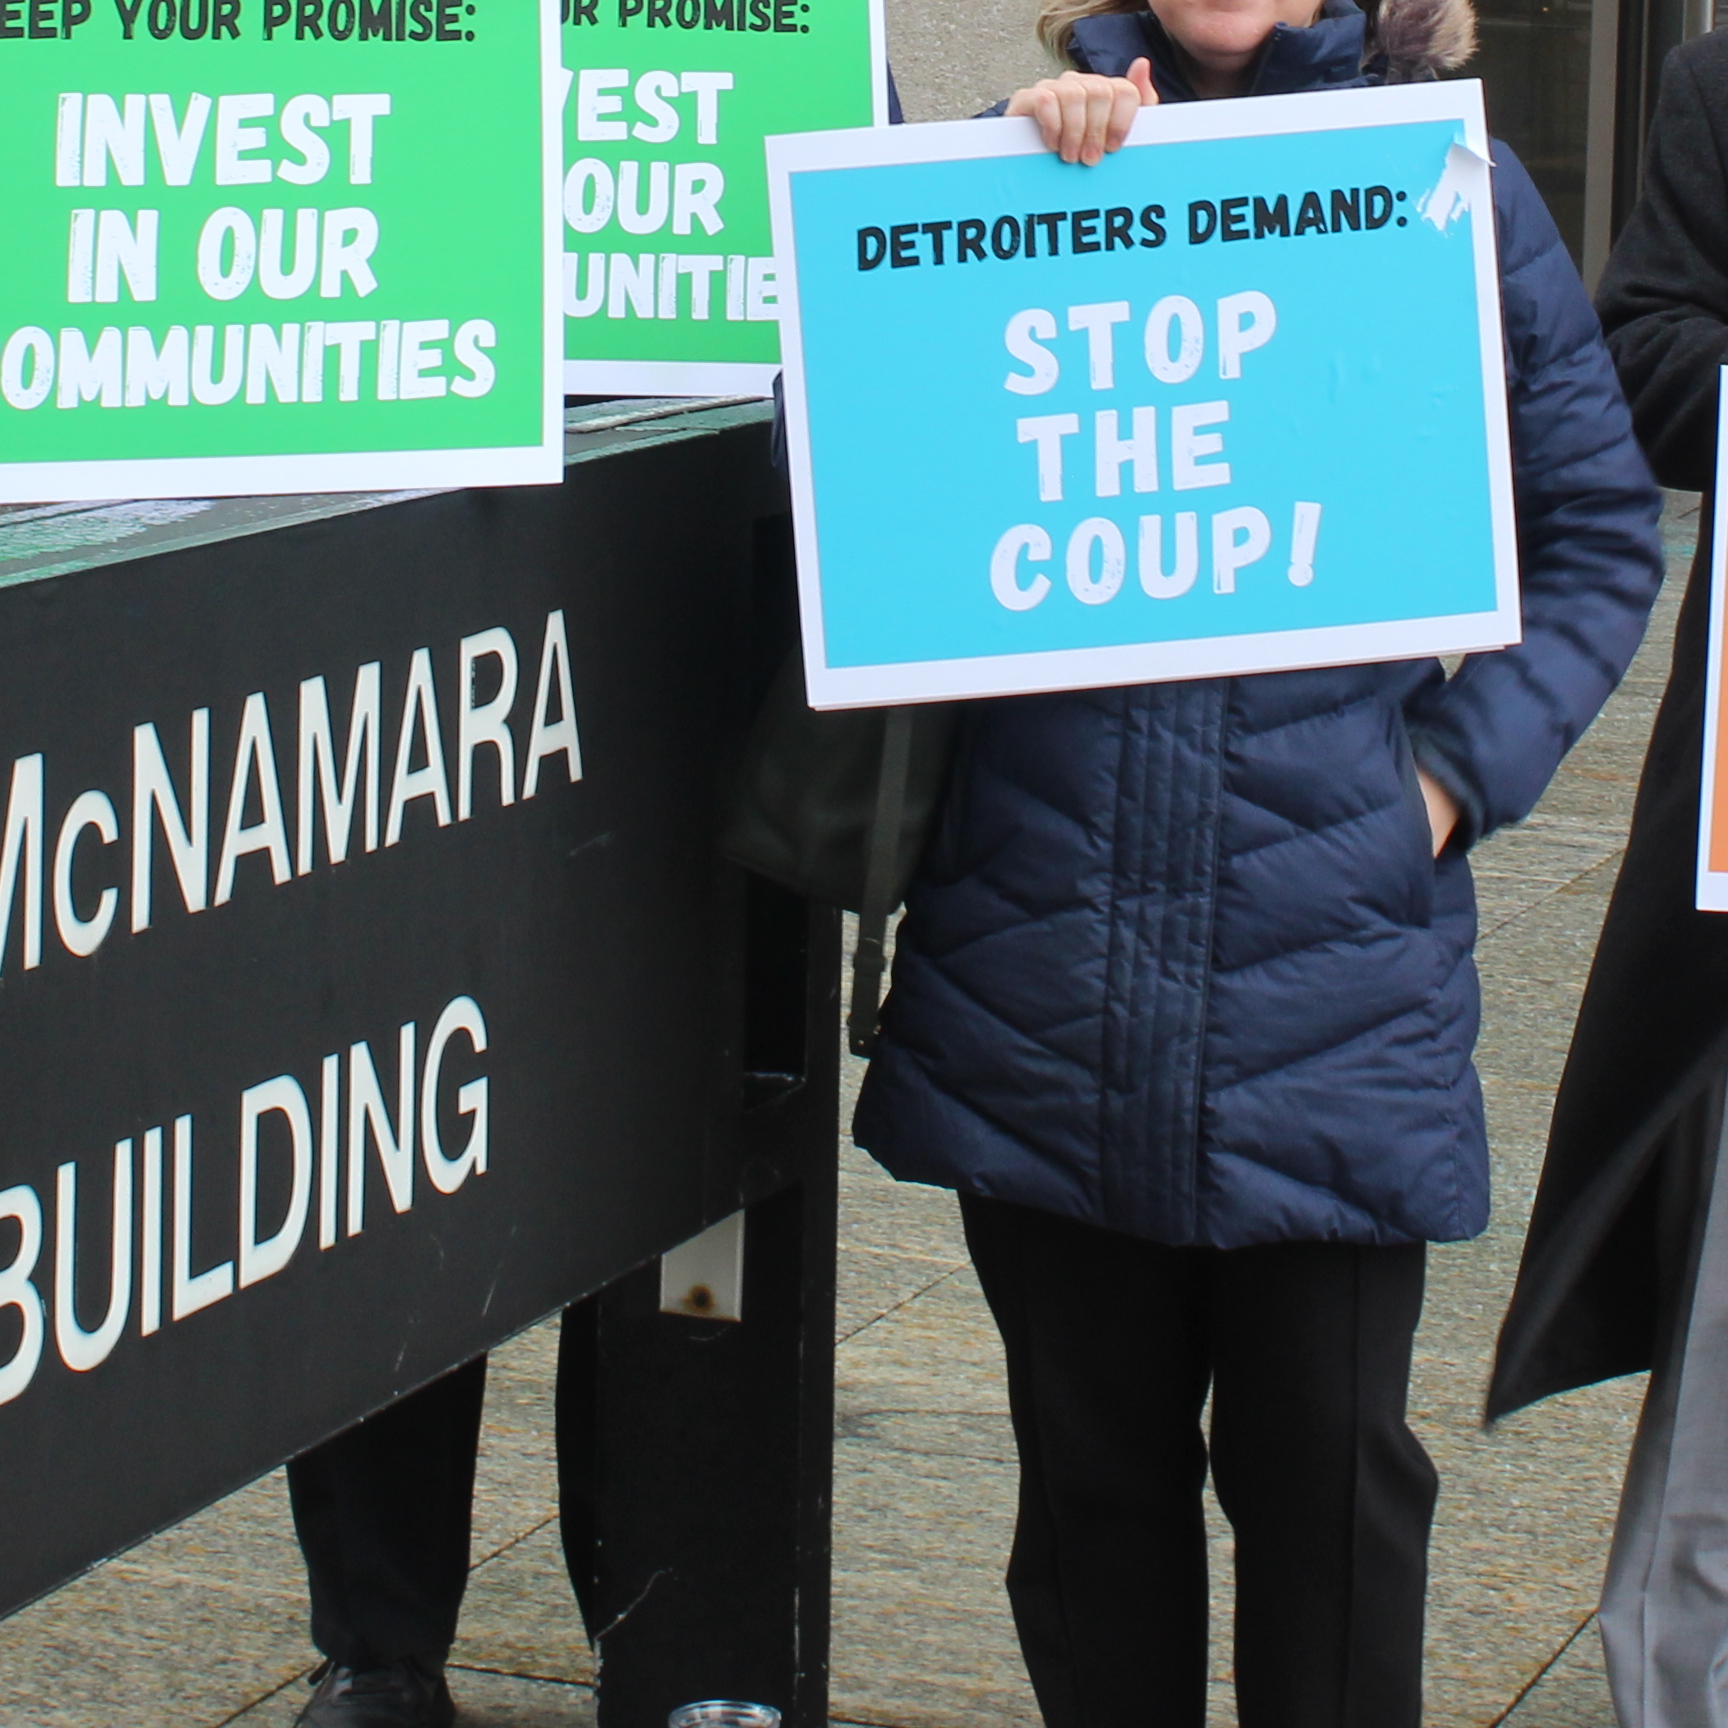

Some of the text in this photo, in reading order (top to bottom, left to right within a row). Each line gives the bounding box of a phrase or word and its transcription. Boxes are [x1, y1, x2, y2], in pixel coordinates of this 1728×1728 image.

[55, 92, 391, 187] INVEST
[562, 158, 725, 235] OUR
[857, 185, 1408, 271] DETROITERS DEMAND:
[67, 206, 379, 303] IN OUR
[1004, 290, 1276, 396] STOP
[1017, 400, 1231, 502] THE
[990, 501, 1322, 612] COUP!
